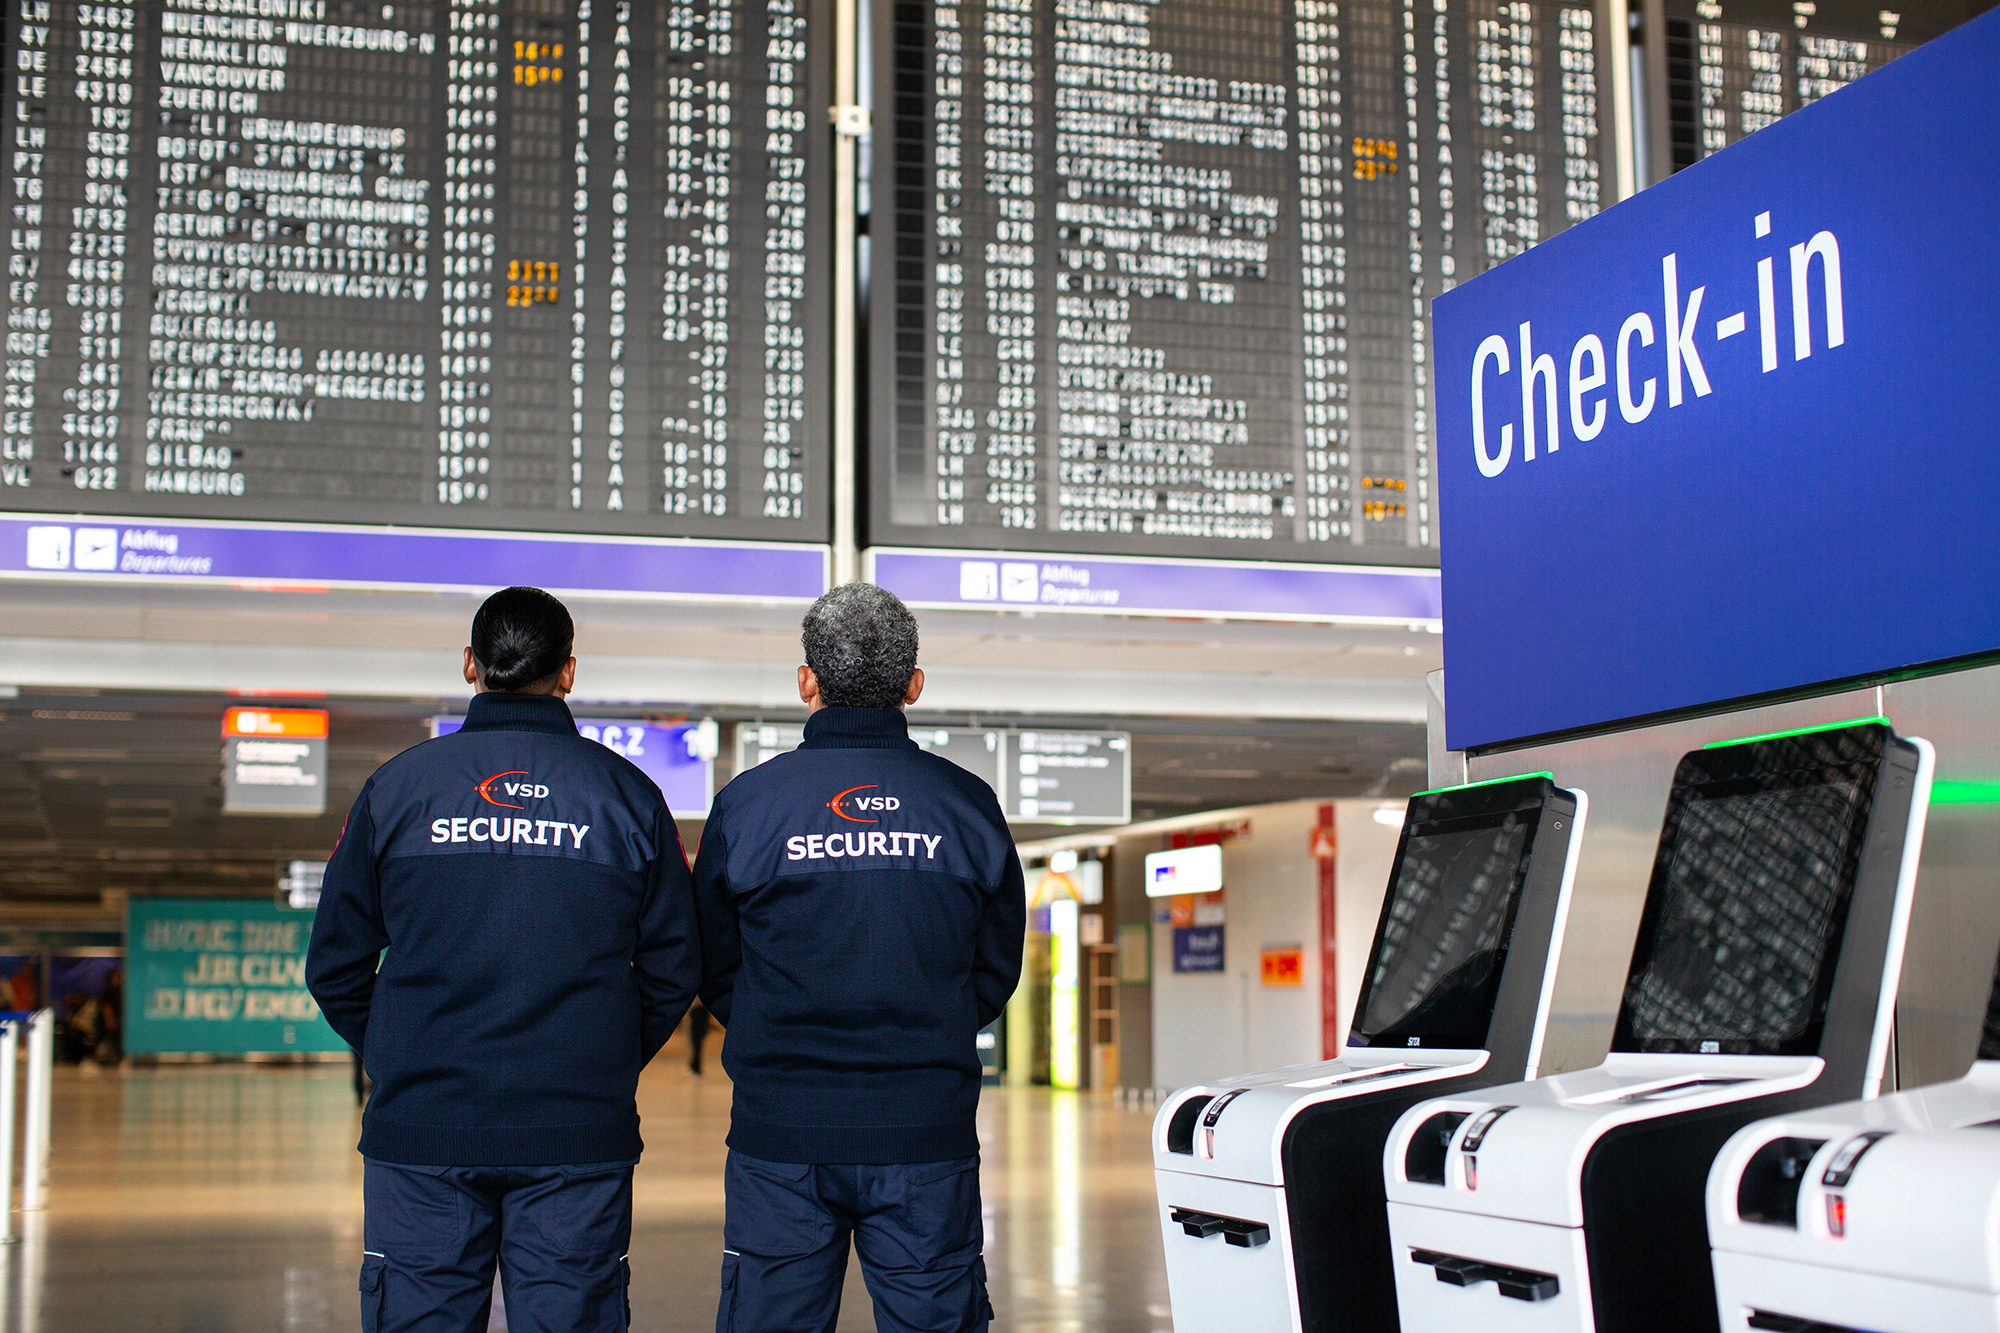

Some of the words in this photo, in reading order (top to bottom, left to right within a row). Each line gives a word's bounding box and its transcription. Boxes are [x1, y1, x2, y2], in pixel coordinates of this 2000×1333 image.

[21, 1, 49, 21] LH
[78, 5, 133, 29] 3462
[615, 49, 630, 68] A
[615, 26, 630, 44] A
[670, 30, 731, 55] 12-13
[767, 39, 805, 60] A24
[17, 50, 46, 71] DE
[76, 55, 131, 78] 2454
[159, 62, 286, 91] VANCOUVER
[20, 25, 48, 46] 4Y
[80, 30, 133, 53] 1224
[160, 37, 287, 68] HERAKLION
[615, 73, 629, 92] A
[669, 78, 730, 100] 12-14
[75, 81, 131, 104] 4319
[159, 87, 257, 113] ZUERICH
[766, 133, 792, 153] A2
[16, 127, 45, 147] LH
[613, 169, 627, 188] A
[668, 173, 729, 196] 12-13
[12, 230, 40, 250] LH
[1470, 210, 1845, 478] Check-in
[3, 438, 33, 459] LH
[65, 441, 117, 463] 1144
[146, 444, 231, 469] BILBAO
[609, 464, 623, 484] A
[664, 467, 726, 490] 12-13
[938, 456, 963, 475] LH
[145, 471, 244, 495] HAMBURG
[608, 490, 622, 509] A
[764, 497, 801, 518] A21
[938, 480, 963, 500] LH
[938, 504, 963, 524] LH
[121, 528, 179, 555] Abflug
[121, 550, 213, 574] Departures
[1041, 563, 1090, 587] Abflug
[504, 783, 550, 799] VSD
[854, 796, 901, 812] VSD
[431, 817, 590, 850] SECURITY
[786, 831, 942, 861] SECURITY
